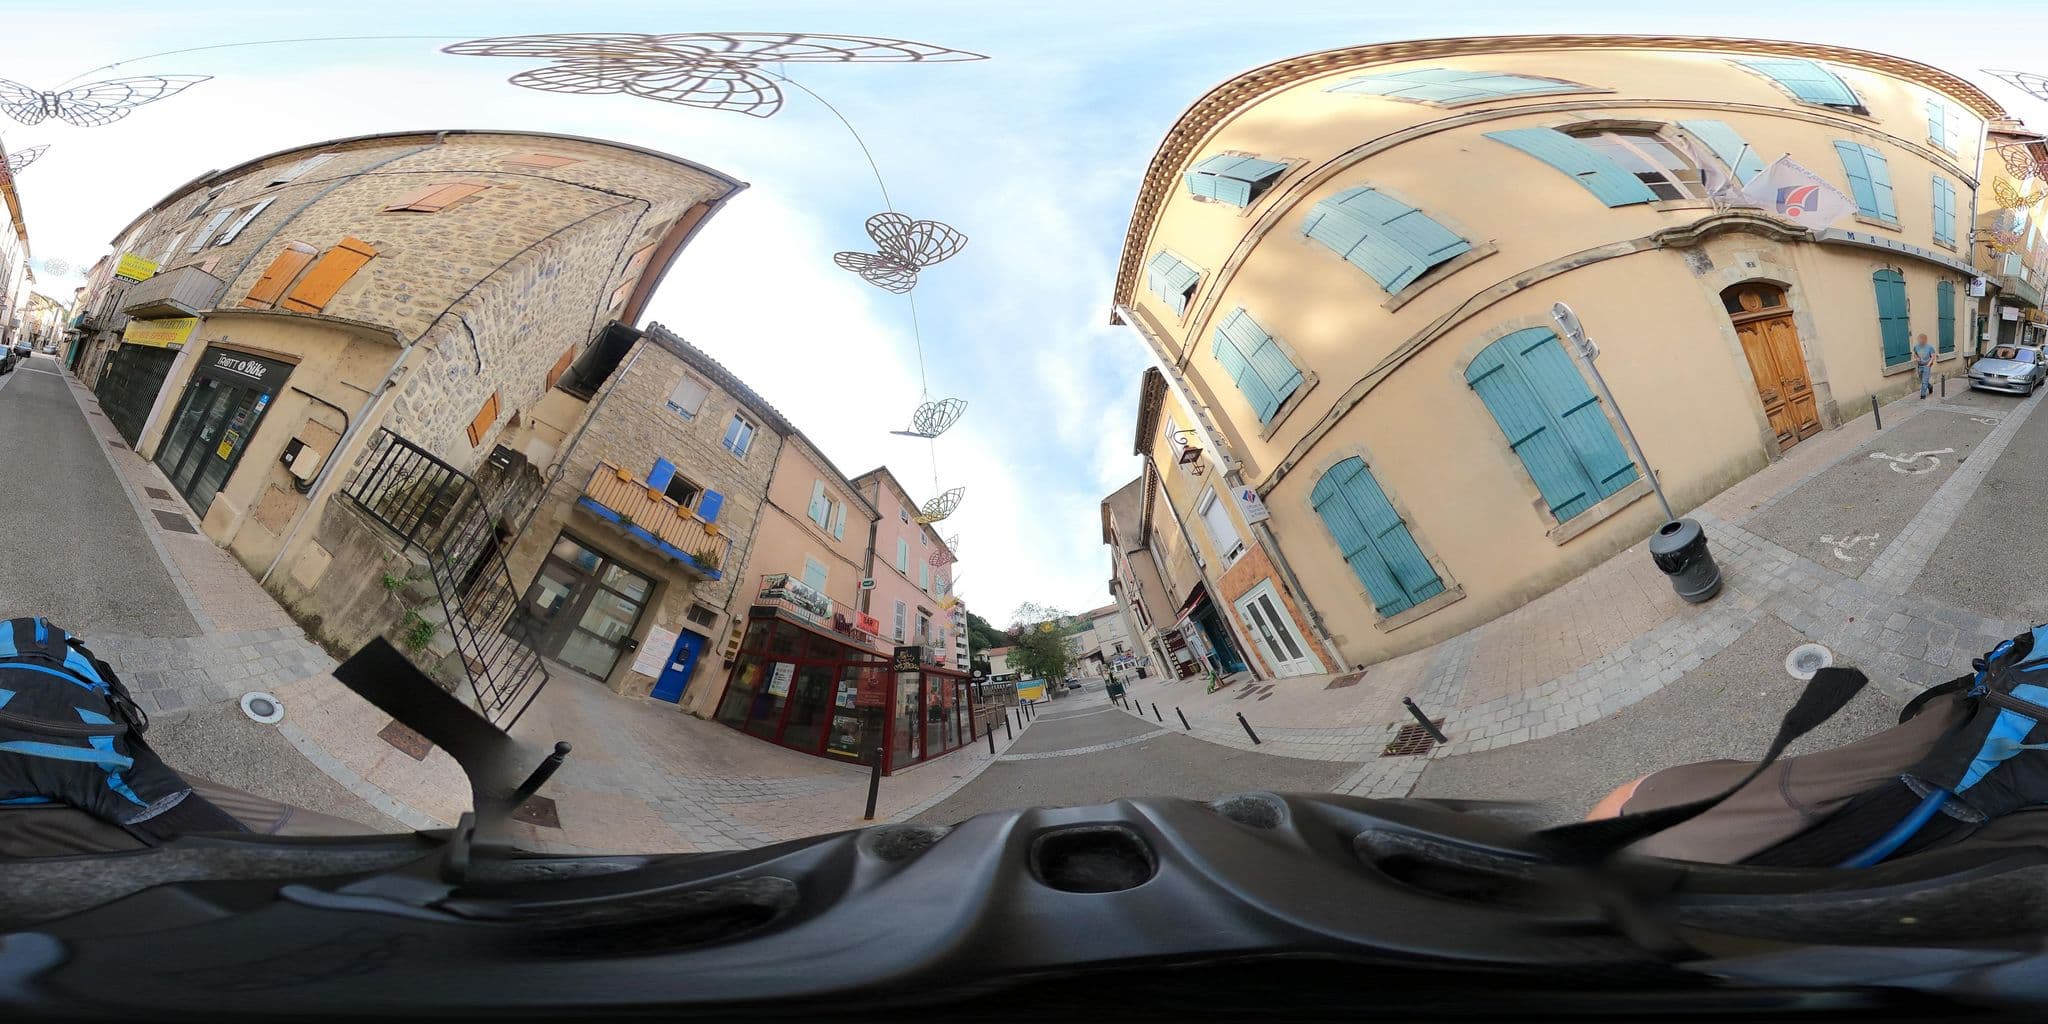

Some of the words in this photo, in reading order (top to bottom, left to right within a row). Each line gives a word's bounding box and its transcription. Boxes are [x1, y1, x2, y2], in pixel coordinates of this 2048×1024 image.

[1847, 231, 1934, 257] MAISON
[244, 360, 267, 377] Bike
[863, 616, 874, 627] BAR
